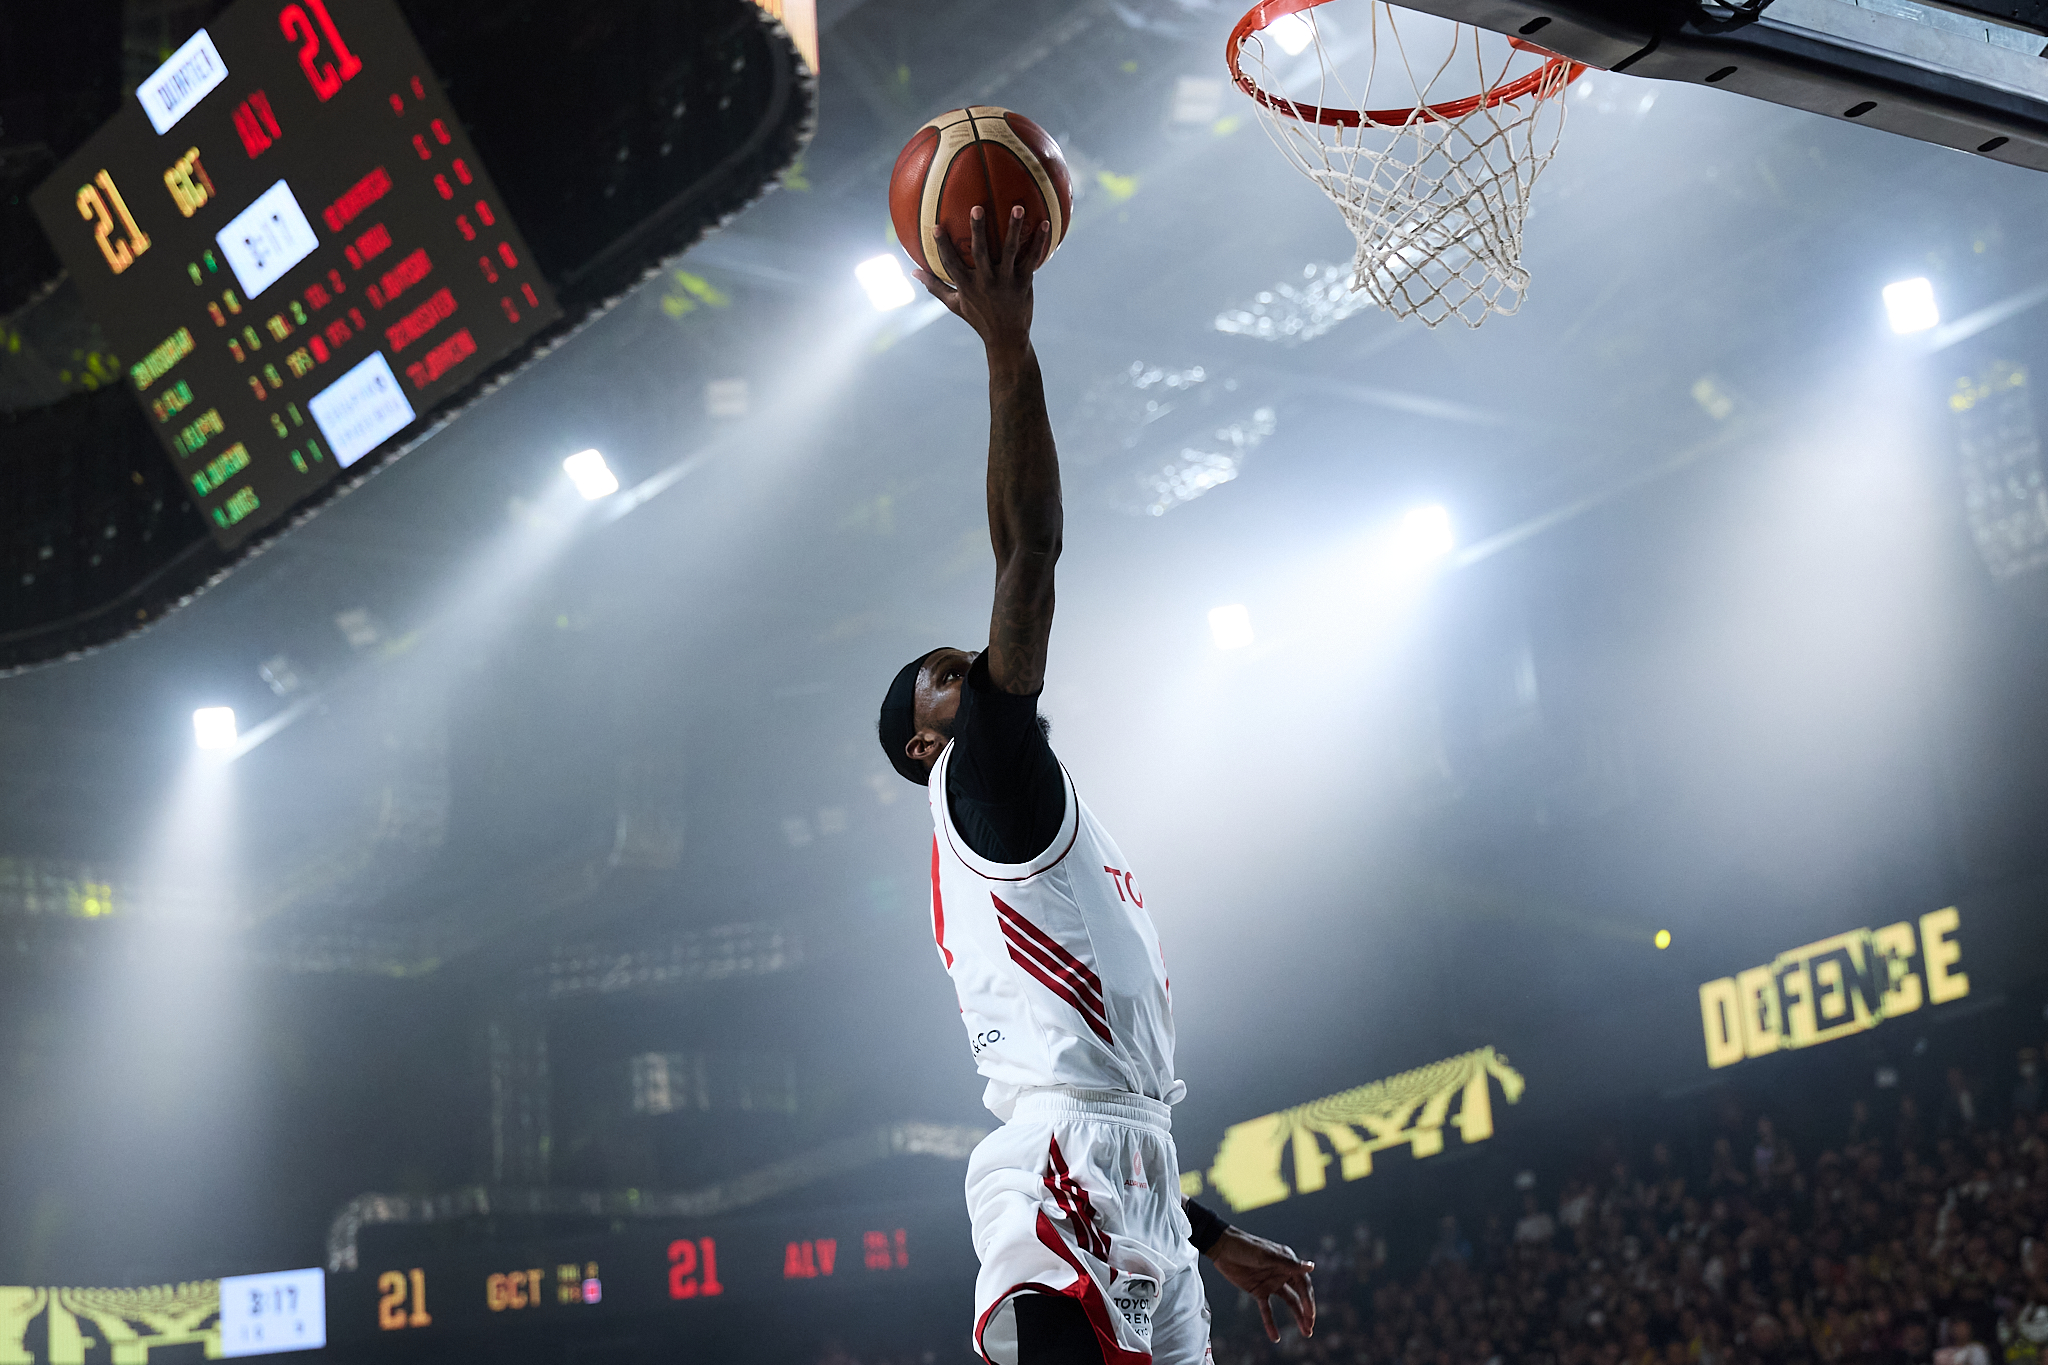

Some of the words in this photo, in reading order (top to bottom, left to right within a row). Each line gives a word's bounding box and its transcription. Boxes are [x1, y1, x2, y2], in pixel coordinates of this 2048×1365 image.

[280, 0, 362, 101] 21
[232, 89, 282, 160] ALV
[164, 146, 216, 218] GCT
[76, 169, 151, 274] 21
[972, 1029, 1006, 1058] &CO.
[377, 1267, 433, 1331] 21
[486, 1268, 545, 1312] GCT
[667, 1236, 724, 1300] 21
[783, 1238, 838, 1279] ALV
[1113, 1297, 1151, 1310] TOYOT
[1123, 1313, 1150, 1324] REN
